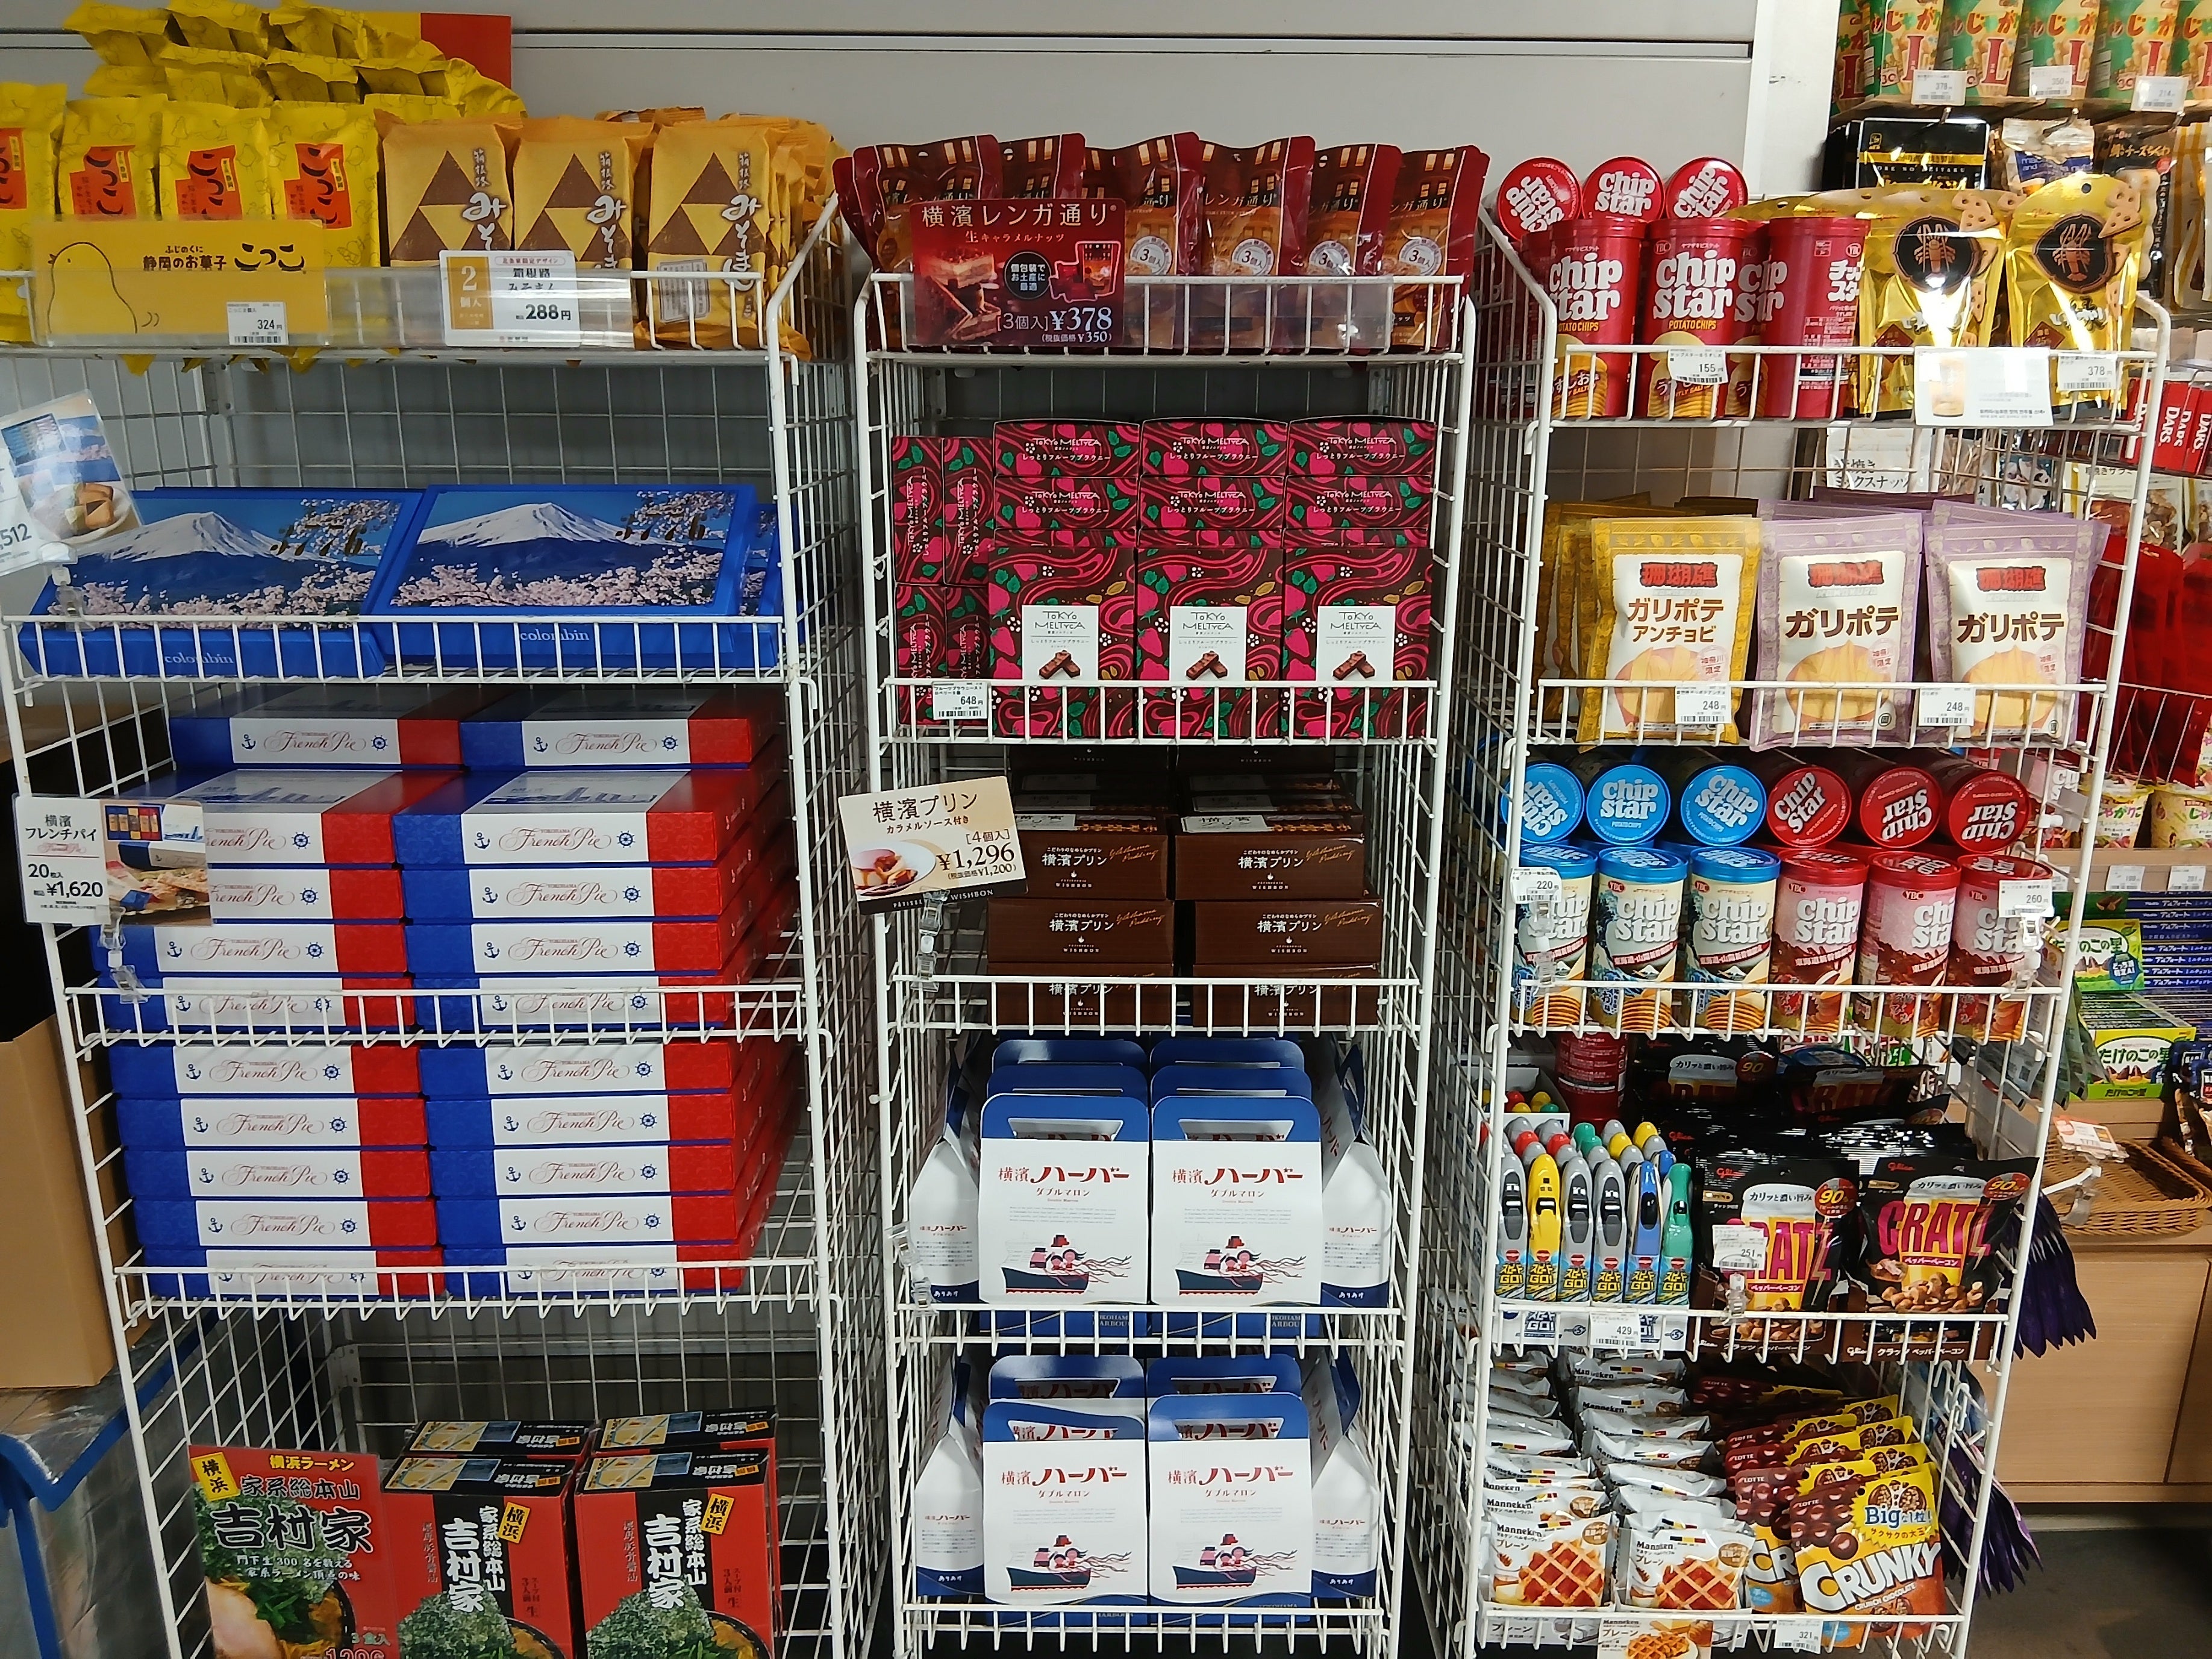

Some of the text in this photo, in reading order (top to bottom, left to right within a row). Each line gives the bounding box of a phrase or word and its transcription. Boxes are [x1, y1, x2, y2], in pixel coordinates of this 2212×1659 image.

[922, 204, 1107, 228] 横濱レンガ通り
[965, 231, 1064, 243] 生キャラメルナッツ
[143, 243, 305, 272] 静岡のお菓子 こっこ
[1011, 264, 1046, 273] 個包装で
[1011, 273, 1046, 282] お土産に
[461, 266, 476, 291] 2
[1020, 282, 1037, 291] 最適
[1654, 284, 1732, 319] star
[1669, 320, 1716, 330] POTATO CHIPS
[2159, 406, 2180, 443] DARS
[2193, 414, 2211, 451] DARS
[1640, 562, 1718, 588] 珊瑚礁
[1628, 598, 1725, 623] ガリポテ
[1786, 605, 1899, 639] ガリポテ
[1957, 611, 2065, 644] ガリポテ
[1632, 625, 1716, 643] アンチョビ
[873, 793, 977, 823] 横濱プリン
[45, 814, 72, 827] 横濱
[887, 815, 969, 834] カラメルソース付き
[25, 828, 96, 842] フレンチパイ
[936, 842, 1015, 871] ¥1,296
[1042, 853, 1107, 866] 横濱プリン
[1238, 855, 1304, 869] 横濱プリン
[46, 881, 103, 898] ¥1,620
[951, 889, 993, 901] WISHBON
[1902, 890, 1924, 900] YBC
[1049, 919, 1114, 933] 横濱プリン
[1257, 920, 1322, 933] 横濱プリン
[1037, 1187, 1090, 1196] ダブルマロン
[1211, 1189, 1264, 1198] ダブルマロン
[1749, 1192, 1813, 1202] カリッと濃い旨み
[1878, 1199, 1993, 1257] CRATZ
[270, 1455, 355, 1471] 横浜ラーメン
[202, 1458, 230, 1493] 横浜
[241, 1476, 360, 1500] 家系総本山
[1205, 1489, 1256, 1498] ダブルマロン
[1487, 1498, 1532, 1510] Manneken
[503, 1506, 528, 1540] 横浜
[705, 1497, 730, 1531] 横浜
[210, 1502, 373, 1553] 吉村家
[1496, 1523, 1543, 1538] Manneken
[480, 1506, 505, 1592] 家系総本山
[682, 1499, 707, 1586] 家系総本山
[1496, 1539, 1529, 1550] プレーン
[442, 1517, 484, 1613] 吉村家
[643, 1513, 686, 1609] 吉村家
[1636, 1555, 1664, 1566] プレーン
[248, 1567, 361, 1581] 家系ラーメン頂点の味
[1799, 1543, 1942, 1612] CRUNKY
[1855, 1584, 1916, 1611] CRUNCH CHOCOLATE
